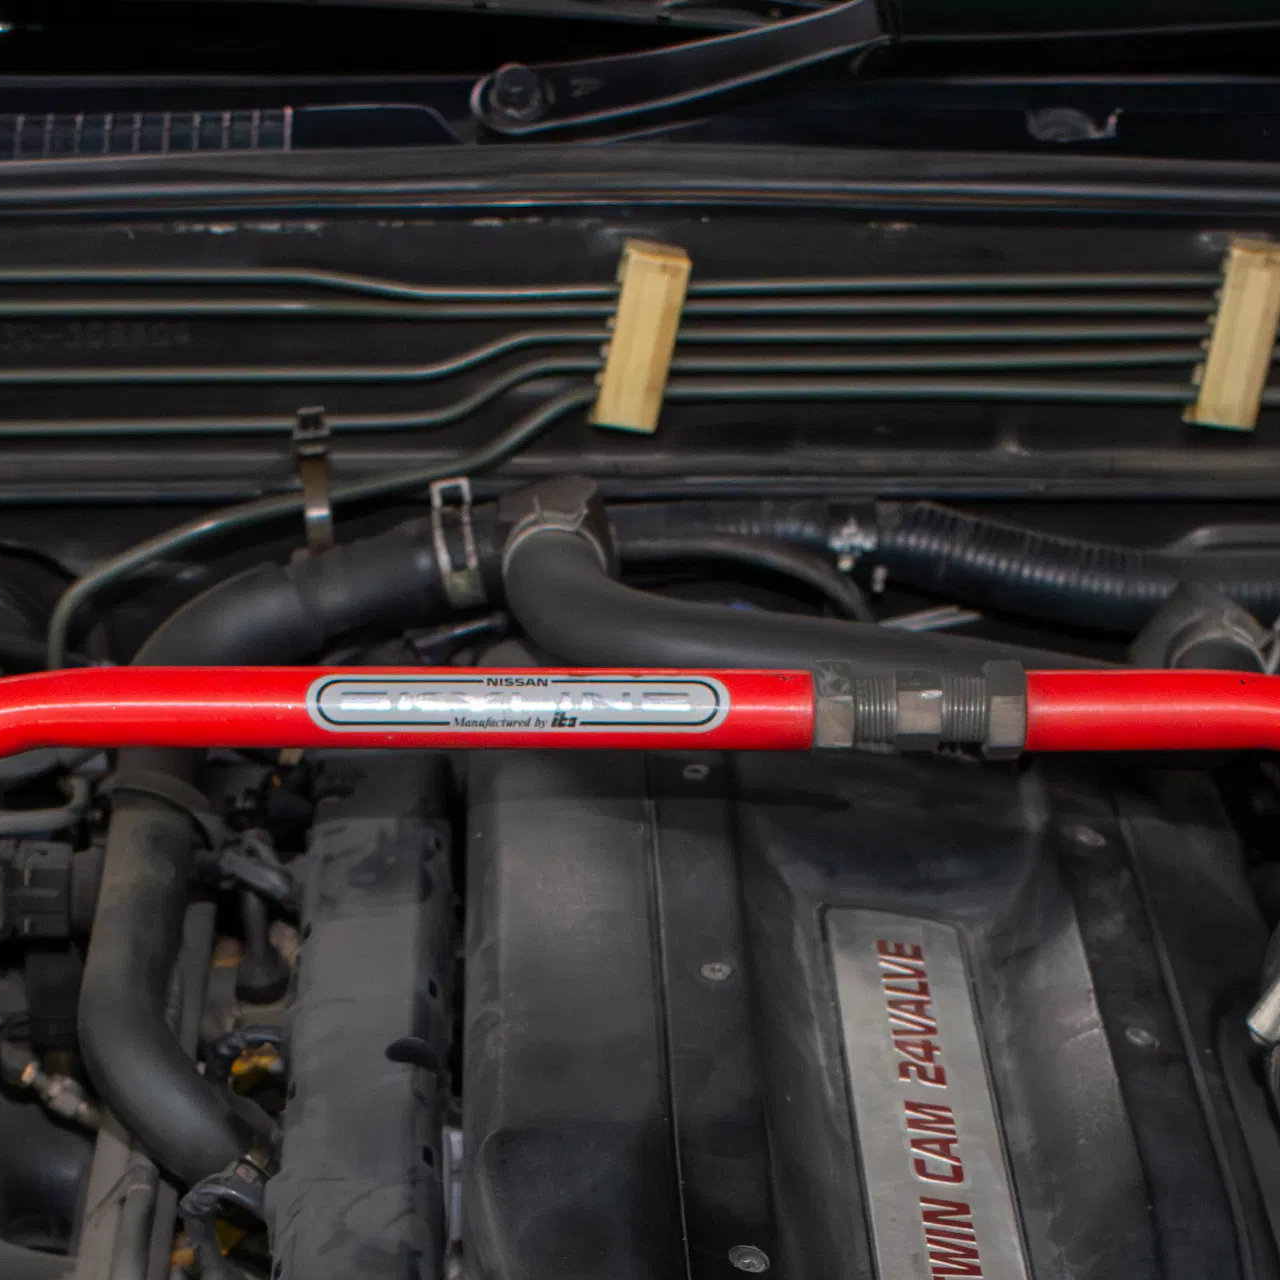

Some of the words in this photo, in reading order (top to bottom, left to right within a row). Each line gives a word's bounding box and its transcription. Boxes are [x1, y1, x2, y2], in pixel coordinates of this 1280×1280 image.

[486, 676, 549, 687] NISSAN
[453, 715, 532, 729] Manufactured
[534, 716, 547, 729] by
[876, 939, 948, 1090] 24VALVE
[904, 1101, 964, 1186] CAM
